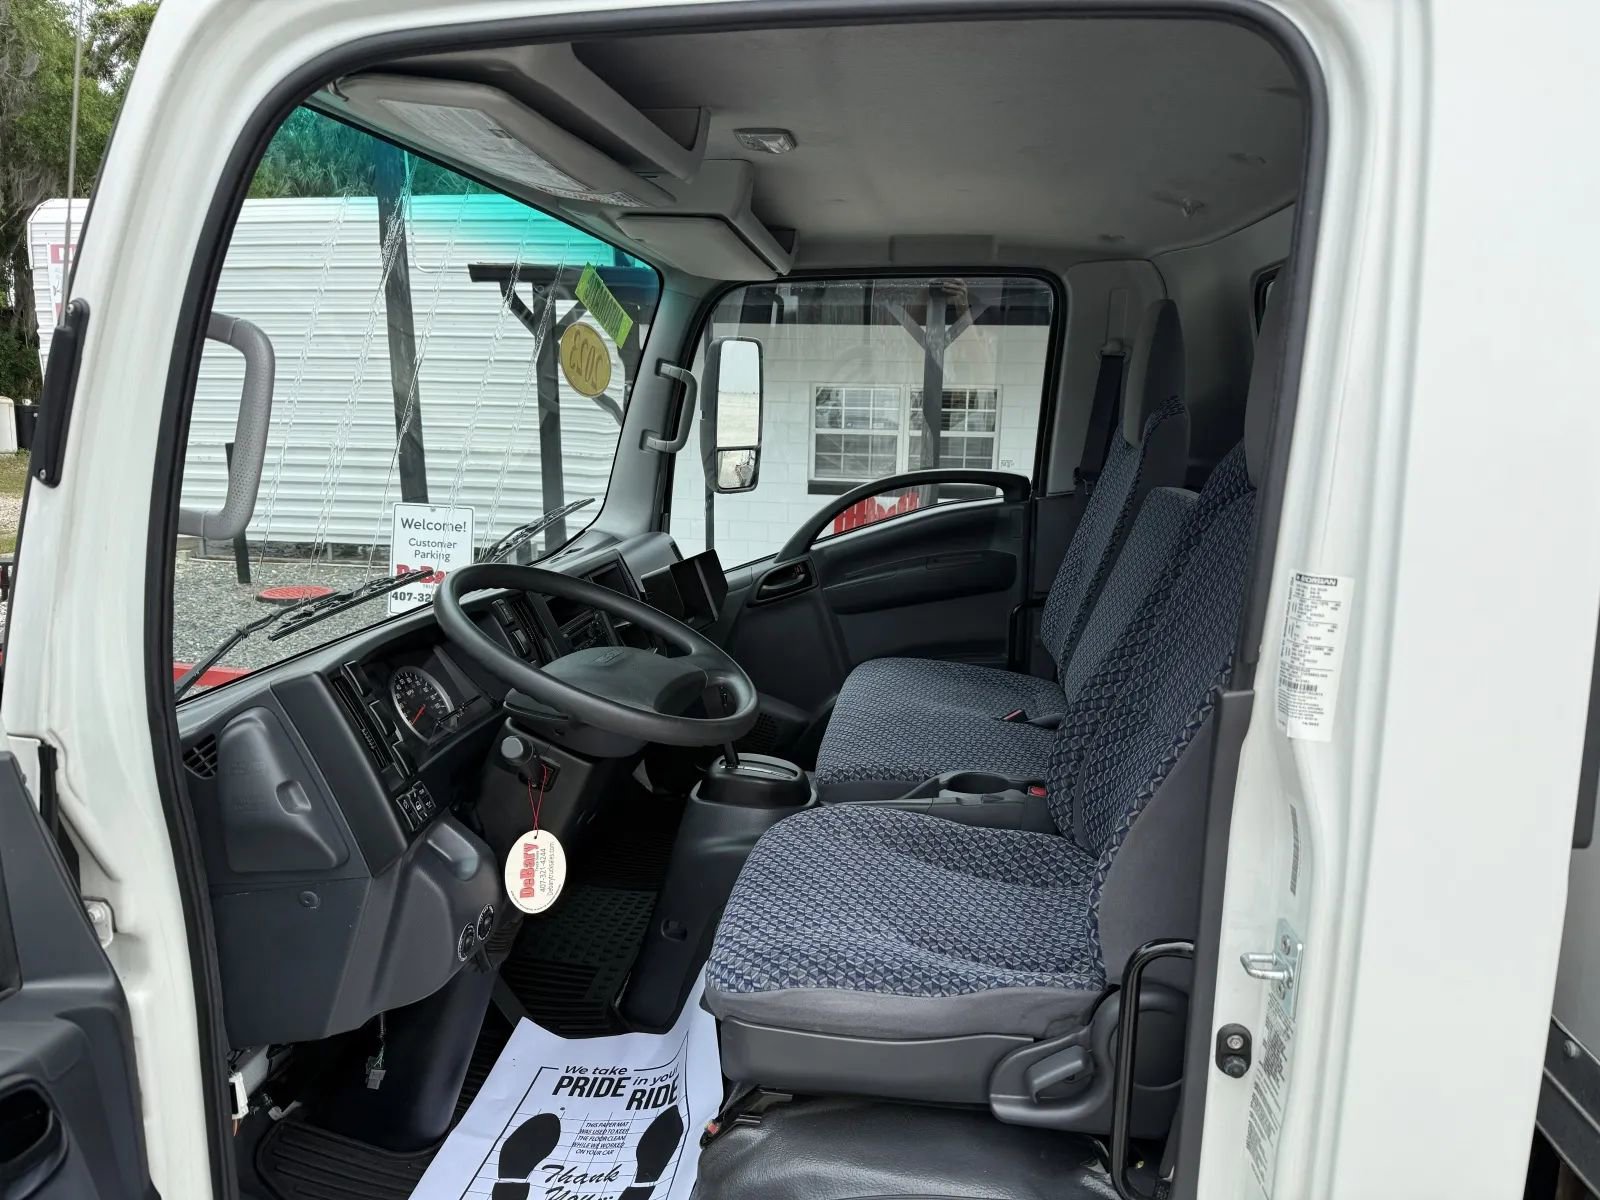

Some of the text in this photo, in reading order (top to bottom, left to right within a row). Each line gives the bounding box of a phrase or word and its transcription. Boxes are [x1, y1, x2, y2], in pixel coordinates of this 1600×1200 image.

[401, 517, 467, 533] Welcome!
[408, 537, 458, 549] Customer
[414, 550, 451, 563] Parking
[520, 843, 539, 898] DeBary
[565, 1065, 628, 1076] We take
[552, 1076, 631, 1098] PRIDE
[633, 1076, 648, 1086] in
[625, 1074, 680, 1111] RIDE
[541, 1163, 623, 1185] Thank
